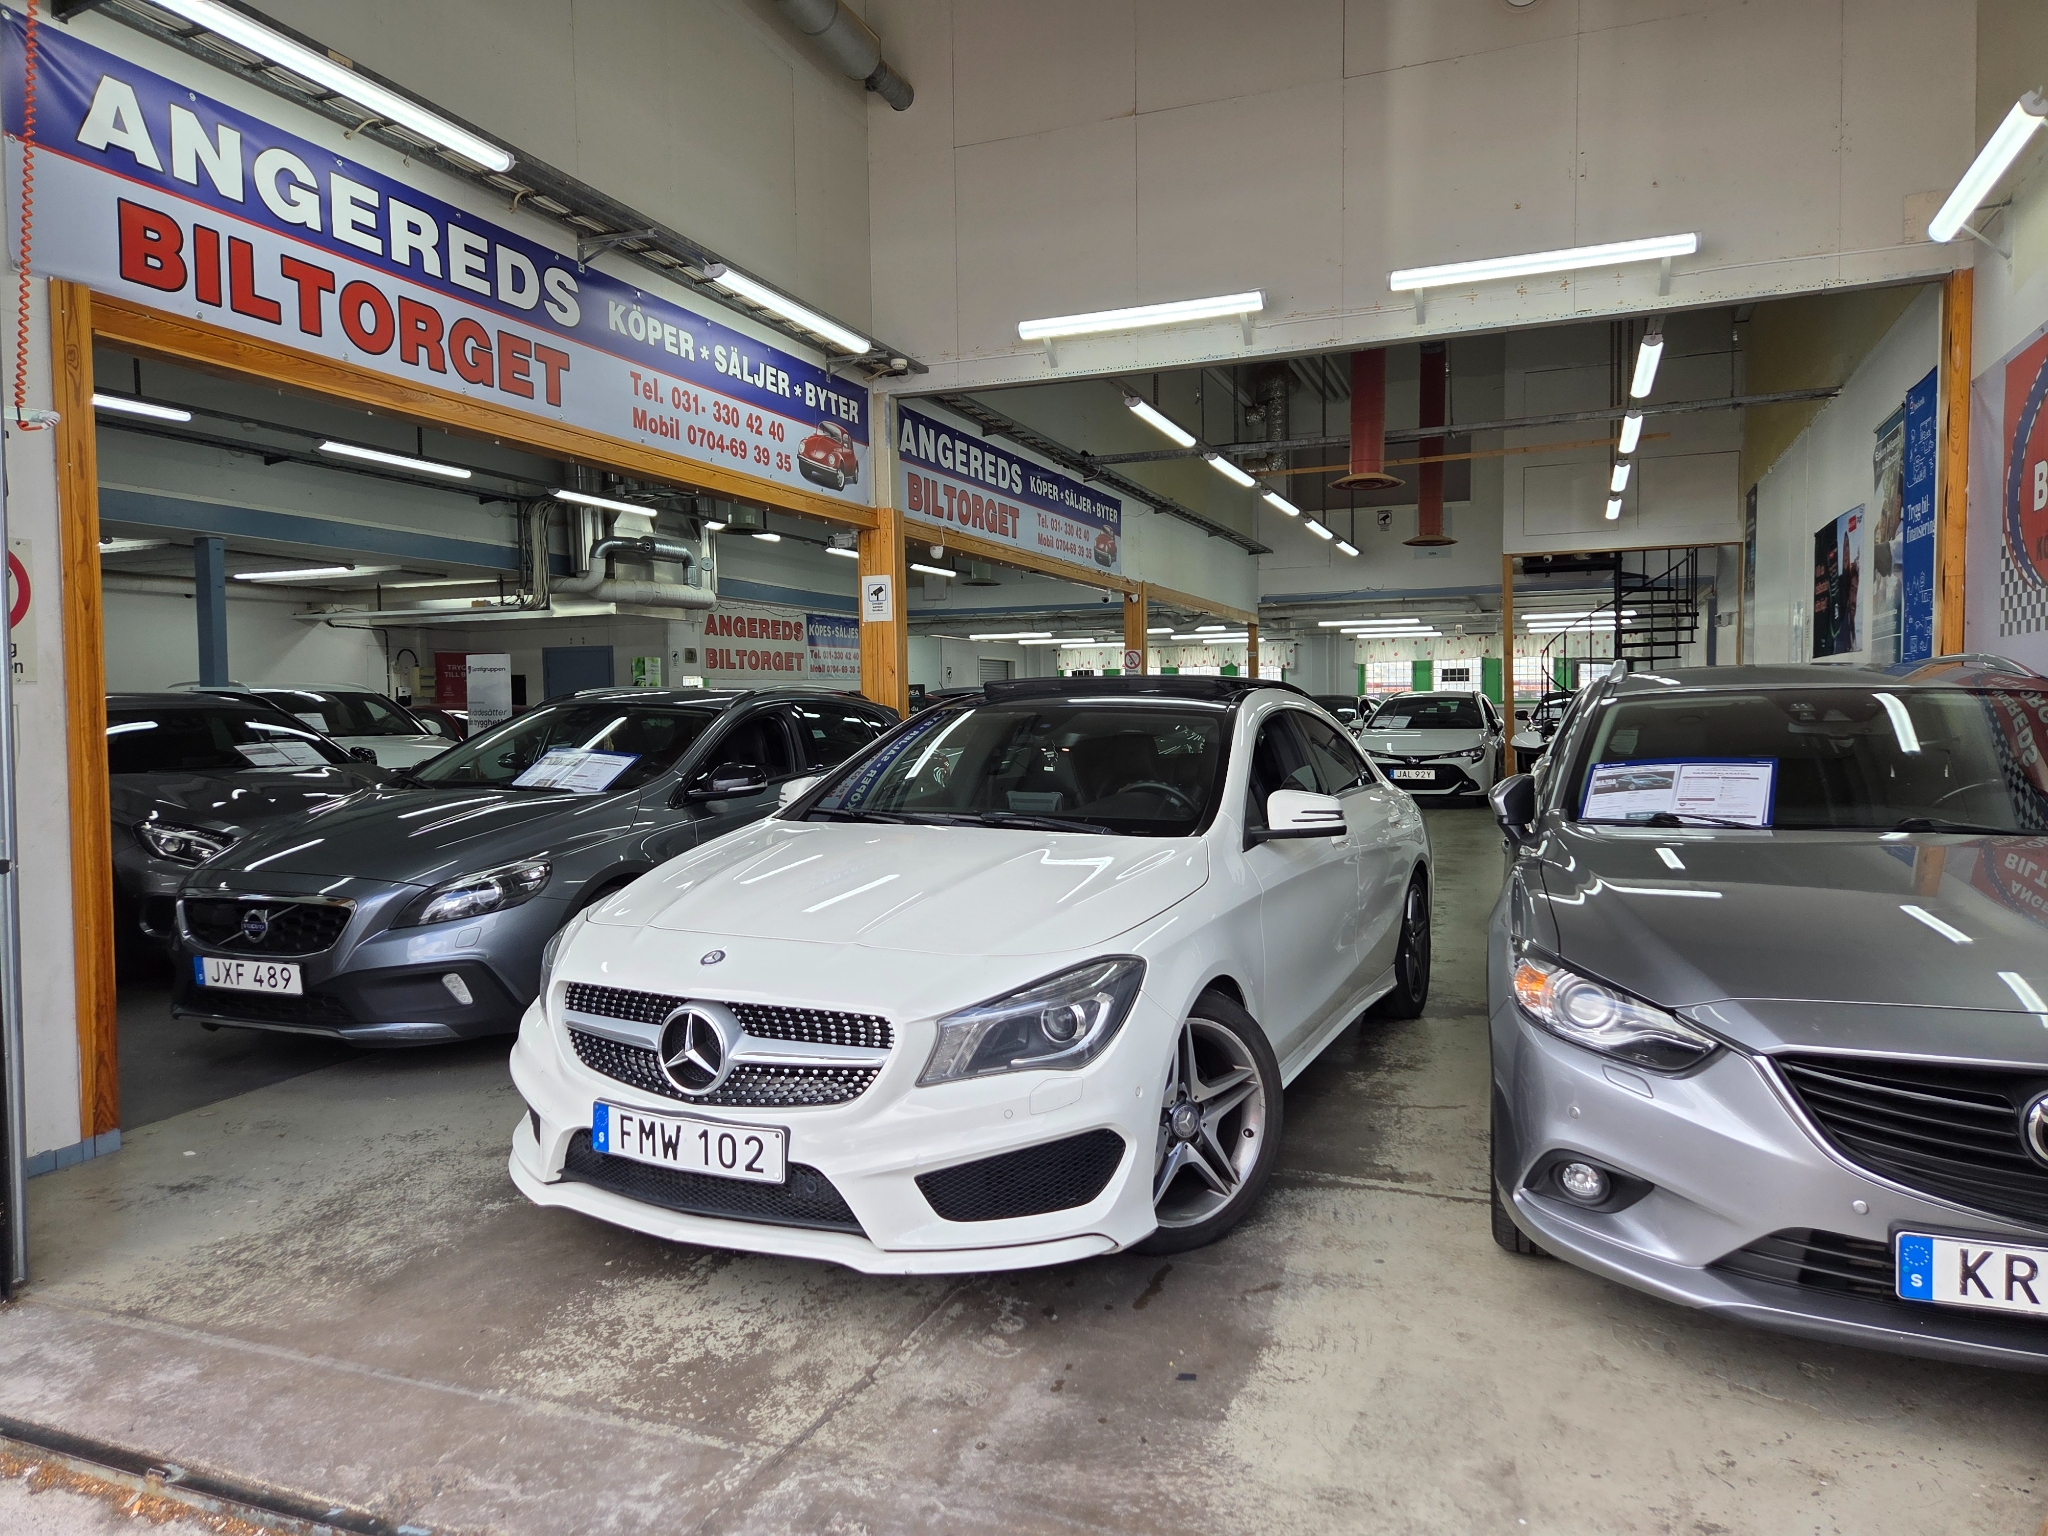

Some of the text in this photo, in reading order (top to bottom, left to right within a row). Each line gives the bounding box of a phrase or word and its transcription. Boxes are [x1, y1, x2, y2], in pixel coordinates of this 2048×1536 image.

[77, 75, 581, 328] ANGEREDS
[117, 197, 570, 407] BILTORGET
[608, 299, 860, 424] KÖPER SÄLJER BYTER
[630, 371, 785, 443] Tel. 031- 330 42 40
[632, 407, 792, 473] Mobil 0704-69 39 35
[900, 418, 1023, 495] ANGEREDS
[907, 471, 1019, 539] BILTORGET
[1029, 475, 1118, 524] KÖPER SÄLJER BYTER
[1037, 532, 1054, 549] Mobil
[704, 613, 804, 642] ANGEREDS
[808, 623, 859, 640] KÖPES SÄLJES
[705, 647, 804, 671] BILTORGET
[1396, 770, 1432, 779] JAL 92Y
[211, 961, 245, 985] JXF
[253, 964, 292, 990] 489
[619, 1113, 682, 1161] FMW
[698, 1128, 764, 1174] 102
[1910, 1248, 2041, 1305] S KR
